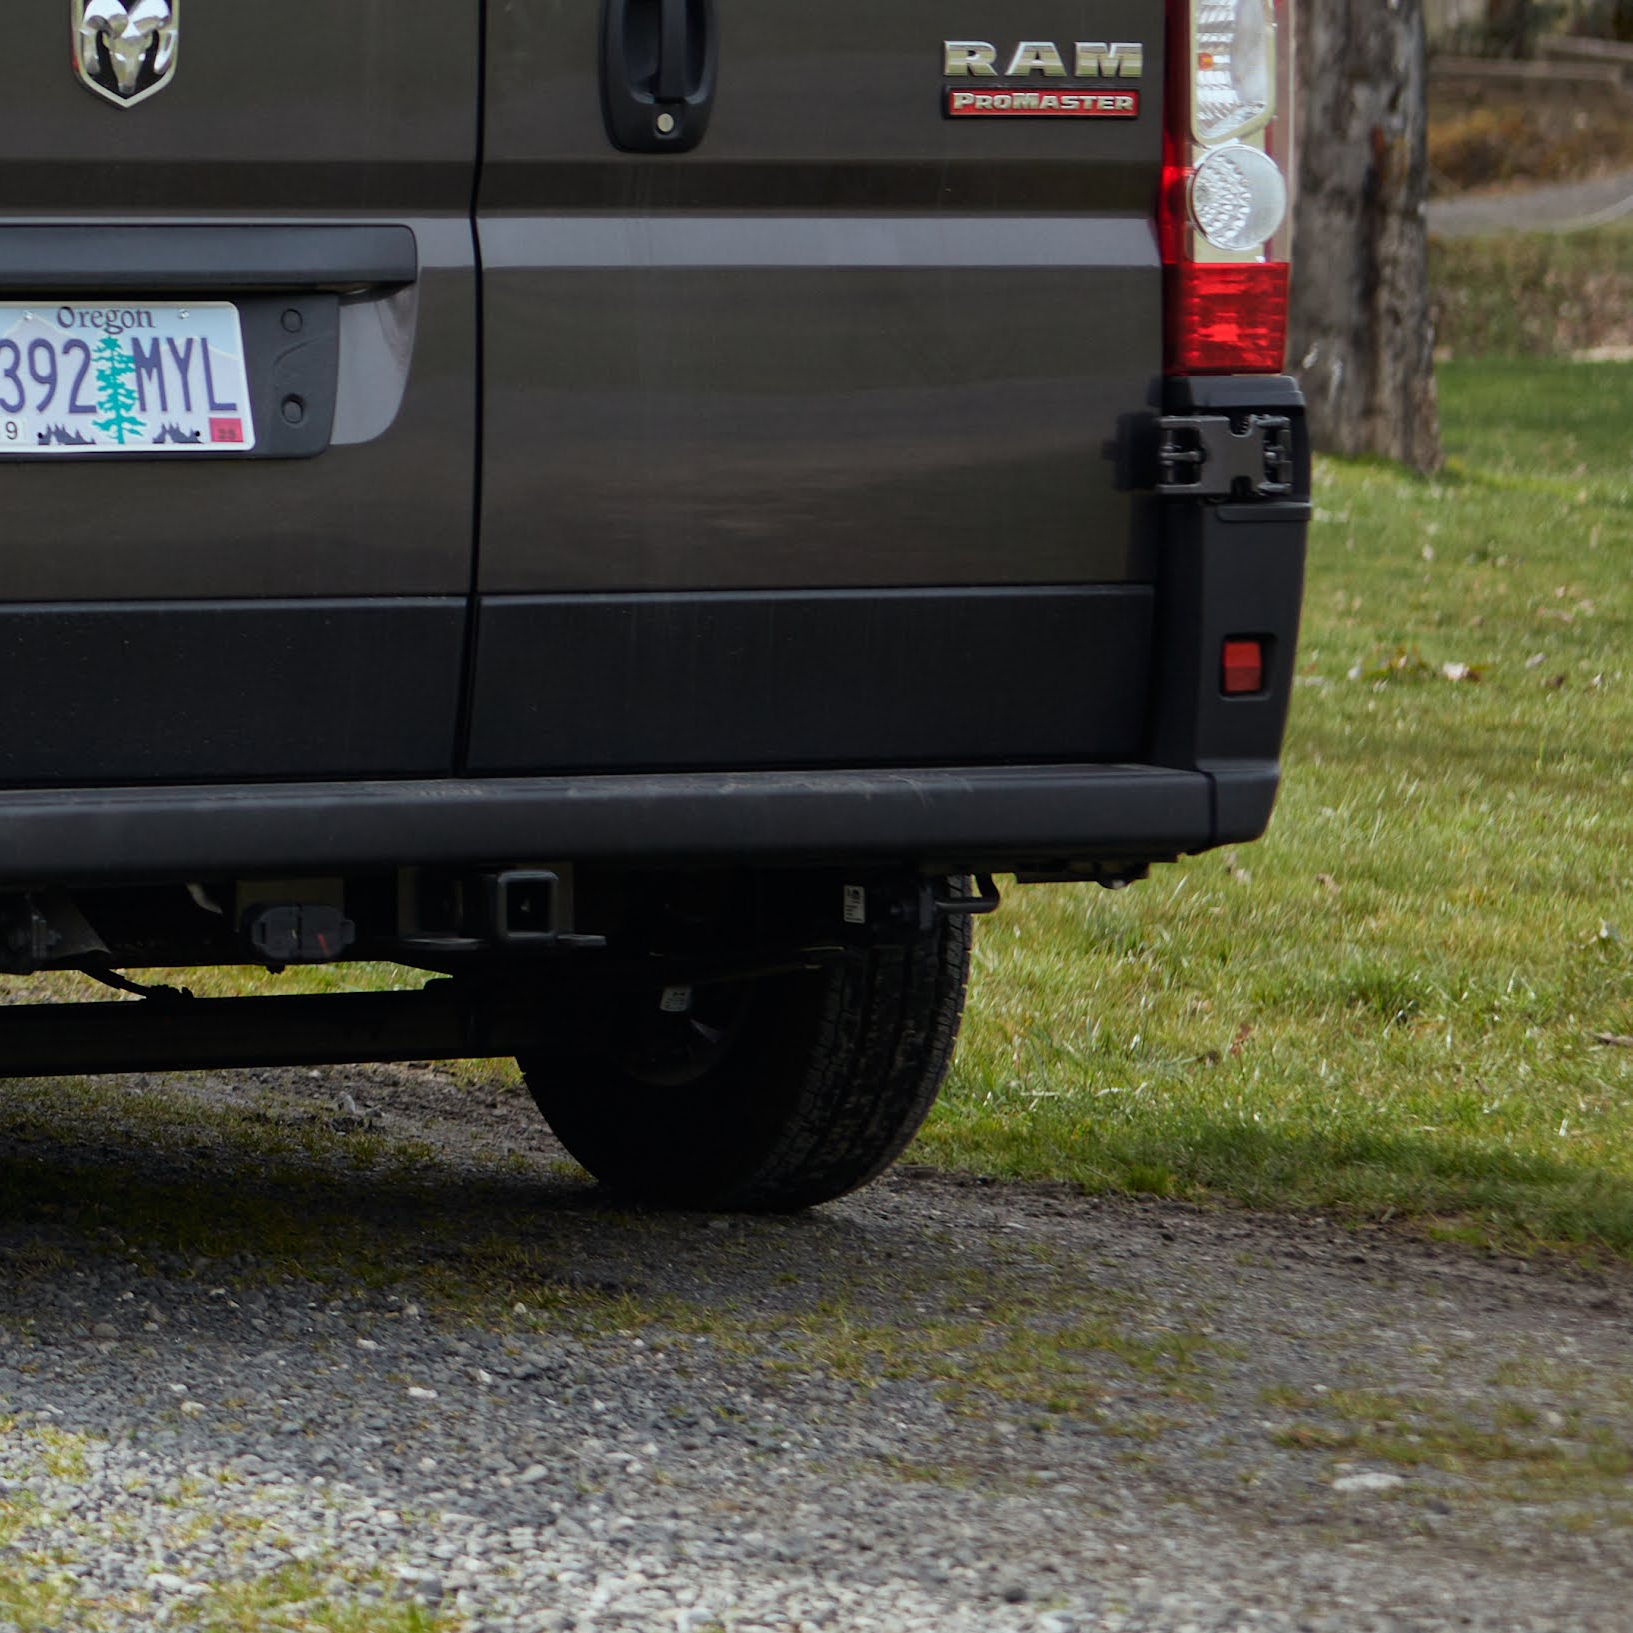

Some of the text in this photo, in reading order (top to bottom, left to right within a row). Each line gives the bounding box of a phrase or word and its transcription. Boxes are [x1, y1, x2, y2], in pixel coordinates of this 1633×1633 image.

[943, 40, 1143, 77] RAM
[57, 306, 156, 335] Oregon
[131, 337, 237, 412] MYL
[5, 421, 18, 440] 9
